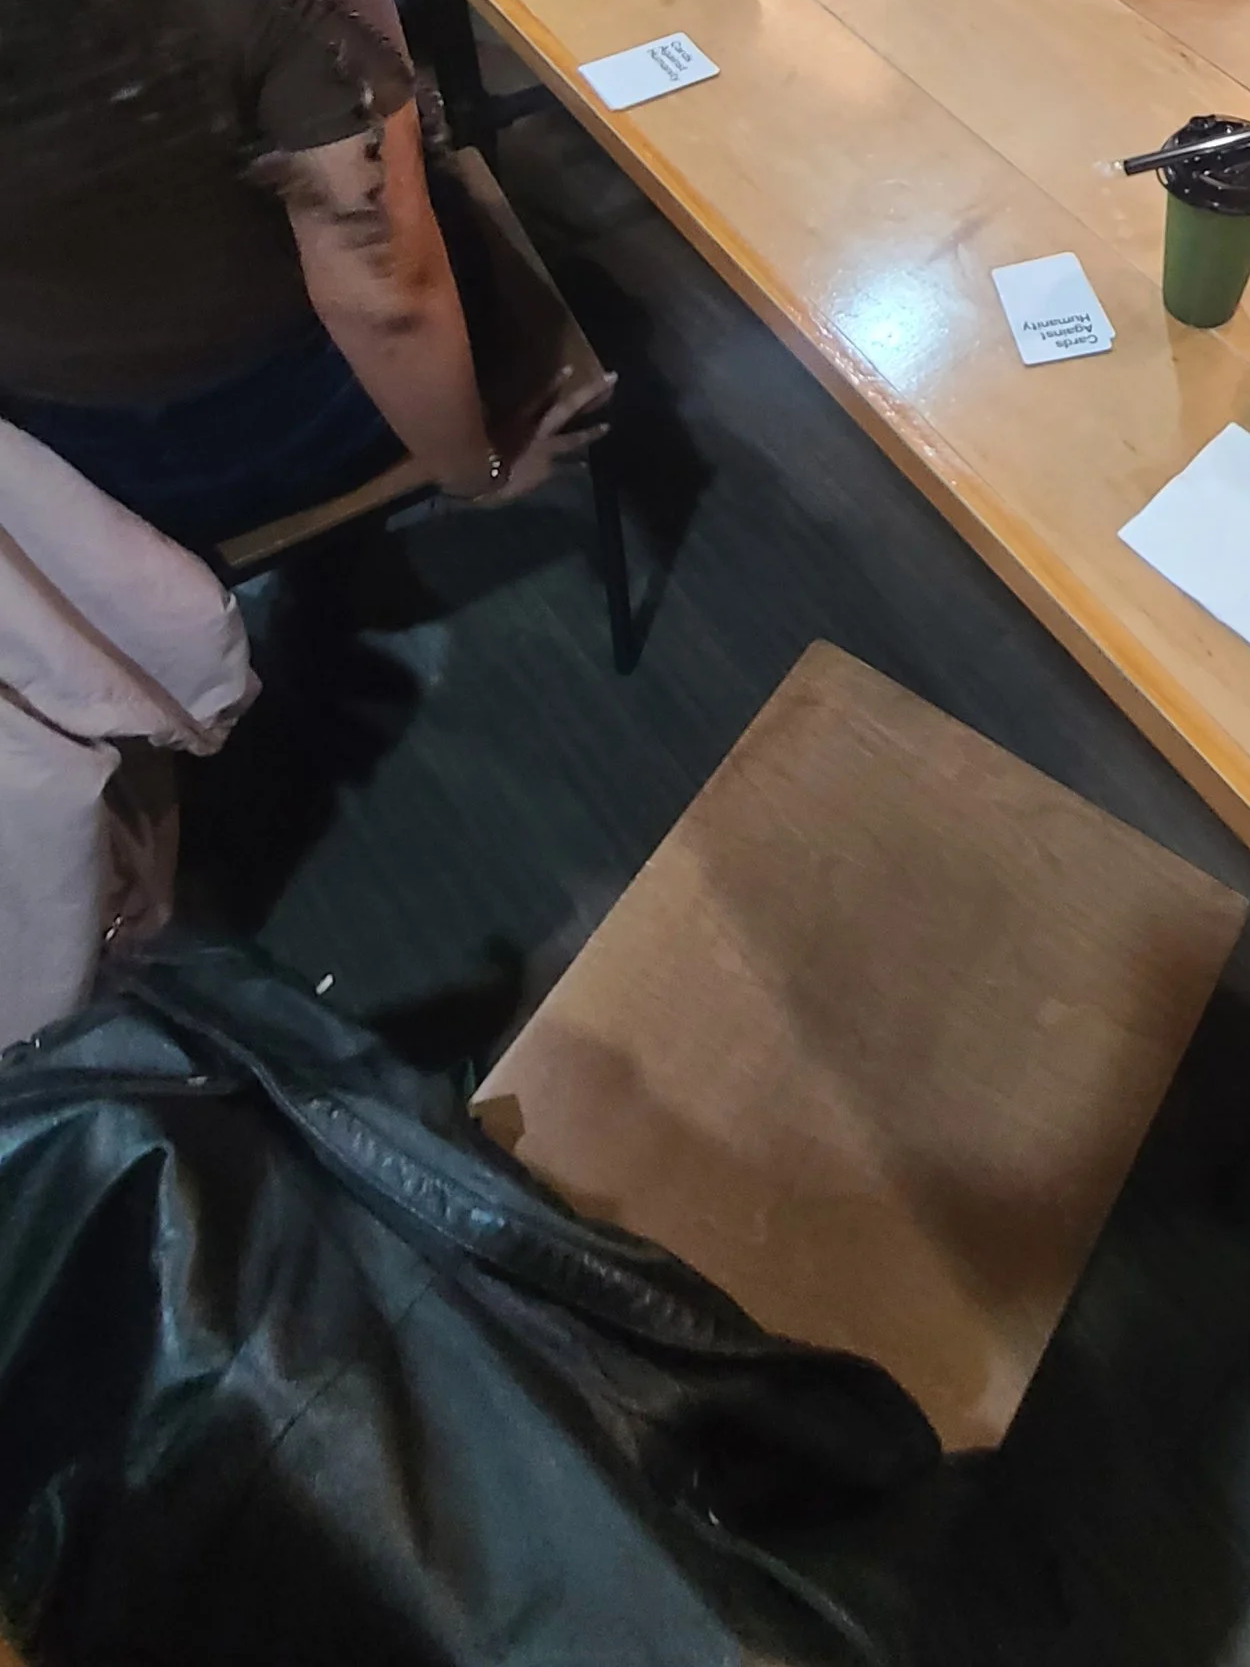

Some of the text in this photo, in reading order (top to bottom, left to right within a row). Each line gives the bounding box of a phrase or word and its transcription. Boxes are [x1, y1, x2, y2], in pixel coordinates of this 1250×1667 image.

[1023, 314, 1091, 332] Humanity
[1040, 323, 1093, 341] Against
[1055, 335, 1098, 349] Cards
